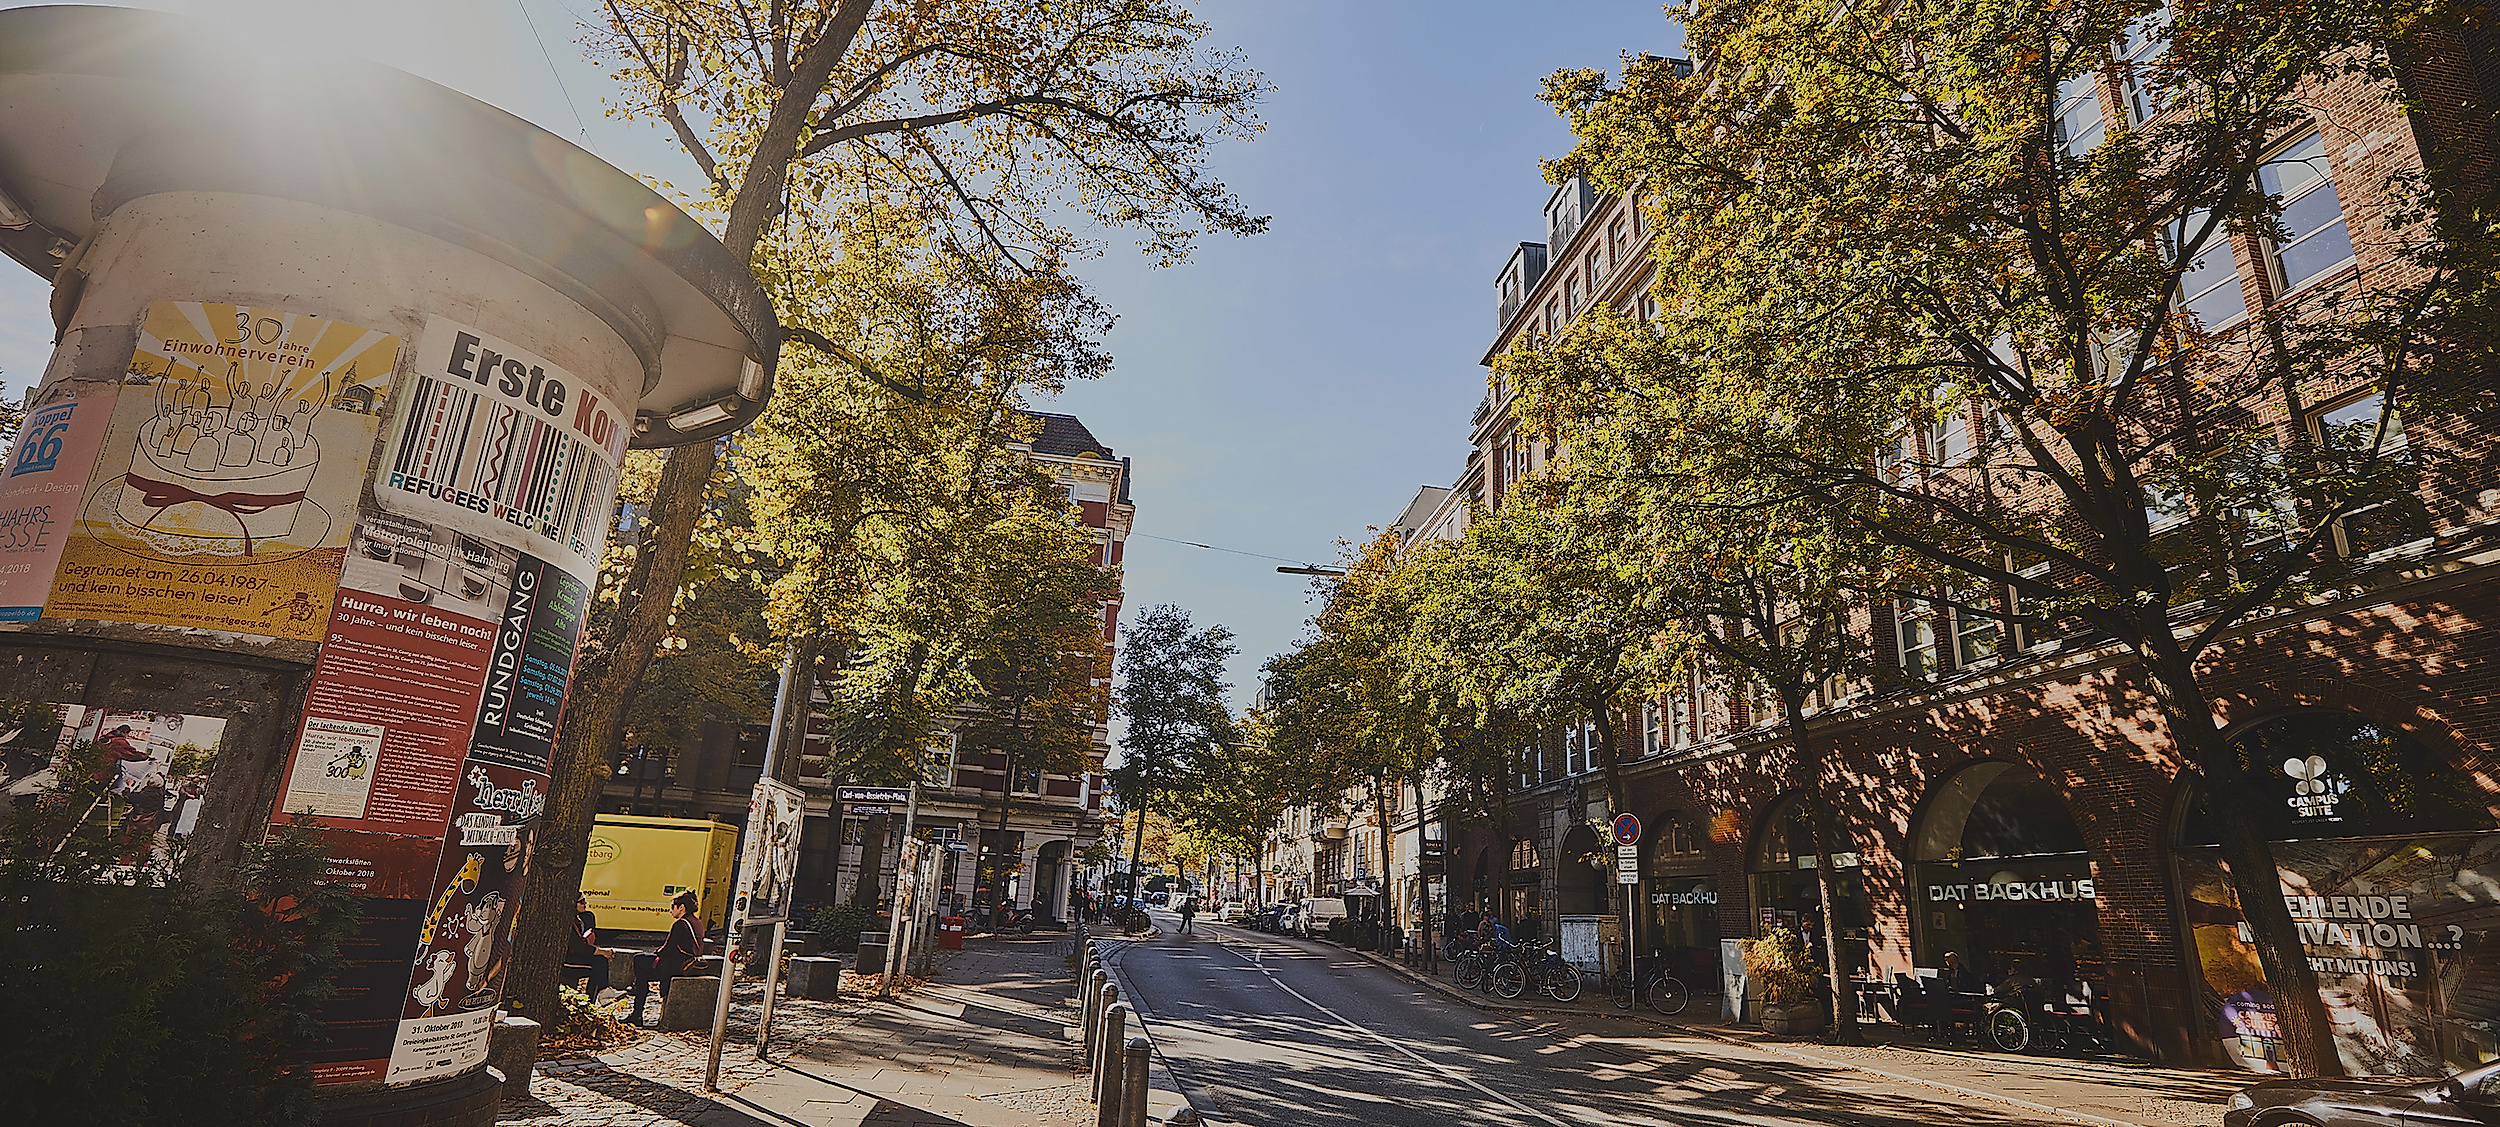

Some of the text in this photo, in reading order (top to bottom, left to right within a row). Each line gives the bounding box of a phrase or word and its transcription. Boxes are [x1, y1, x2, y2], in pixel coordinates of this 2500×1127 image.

[225, 312, 284, 345] 30
[163, 339, 316, 369] Einwohnerverein
[278, 340, 311, 354] Jahre
[446, 330, 567, 417] Erste
[31, 406, 75, 429] Koppel
[17, 422, 70, 464] 66
[44, 482, 79, 495] Design
[388, 471, 560, 544] REFUGEES WELCOME
[364, 514, 434, 536] Veranstaltungsreihe
[361, 524, 511, 574] Metropolenpolitik Hamburg
[64, 561, 142, 580] Gegründet
[145, 570, 174, 582] am
[177, 568, 268, 592] 26.04.1987
[58, 579, 251, 608] und kein bisschen leiser!
[180, 611, 272, 630] www.ev-stgeorg.de
[340, 596, 493, 641] Hurra, wir leben noch!
[330, 633, 344, 643] 95
[336, 612, 350, 622] 30
[349, 614, 376, 628] Jahre
[385, 622, 404, 633] und
[405, 624, 424, 638] kein
[425, 630, 459, 647] bisschen
[458, 638, 479, 651] leiser
[483, 570, 536, 726] RUNDGANG
[524, 653, 549, 670] Samstag,
[522, 664, 547, 681] Samstag,
[519, 675, 544, 692] Samstag,
[307, 720, 370, 735] Der lachende Drache
[325, 765, 350, 778] 300
[2287, 794, 2340, 808] CAMPUS
[2297, 805, 2334, 817] SUITE
[325, 867, 375, 878] Oktober 2018
[1652, 893, 1672, 905] DAT
[1928, 878, 2096, 901] DAT BACKHUS
[2335, 957, 2369, 975] MIT
[2371, 959, 2418, 977] UNS!
[2238, 1010, 2278, 1022] CAMPUS
[2245, 1018, 2275, 1031] SUITE
[411, 1025, 423, 1035] 31.
[424, 1021, 451, 1034] Oktober
